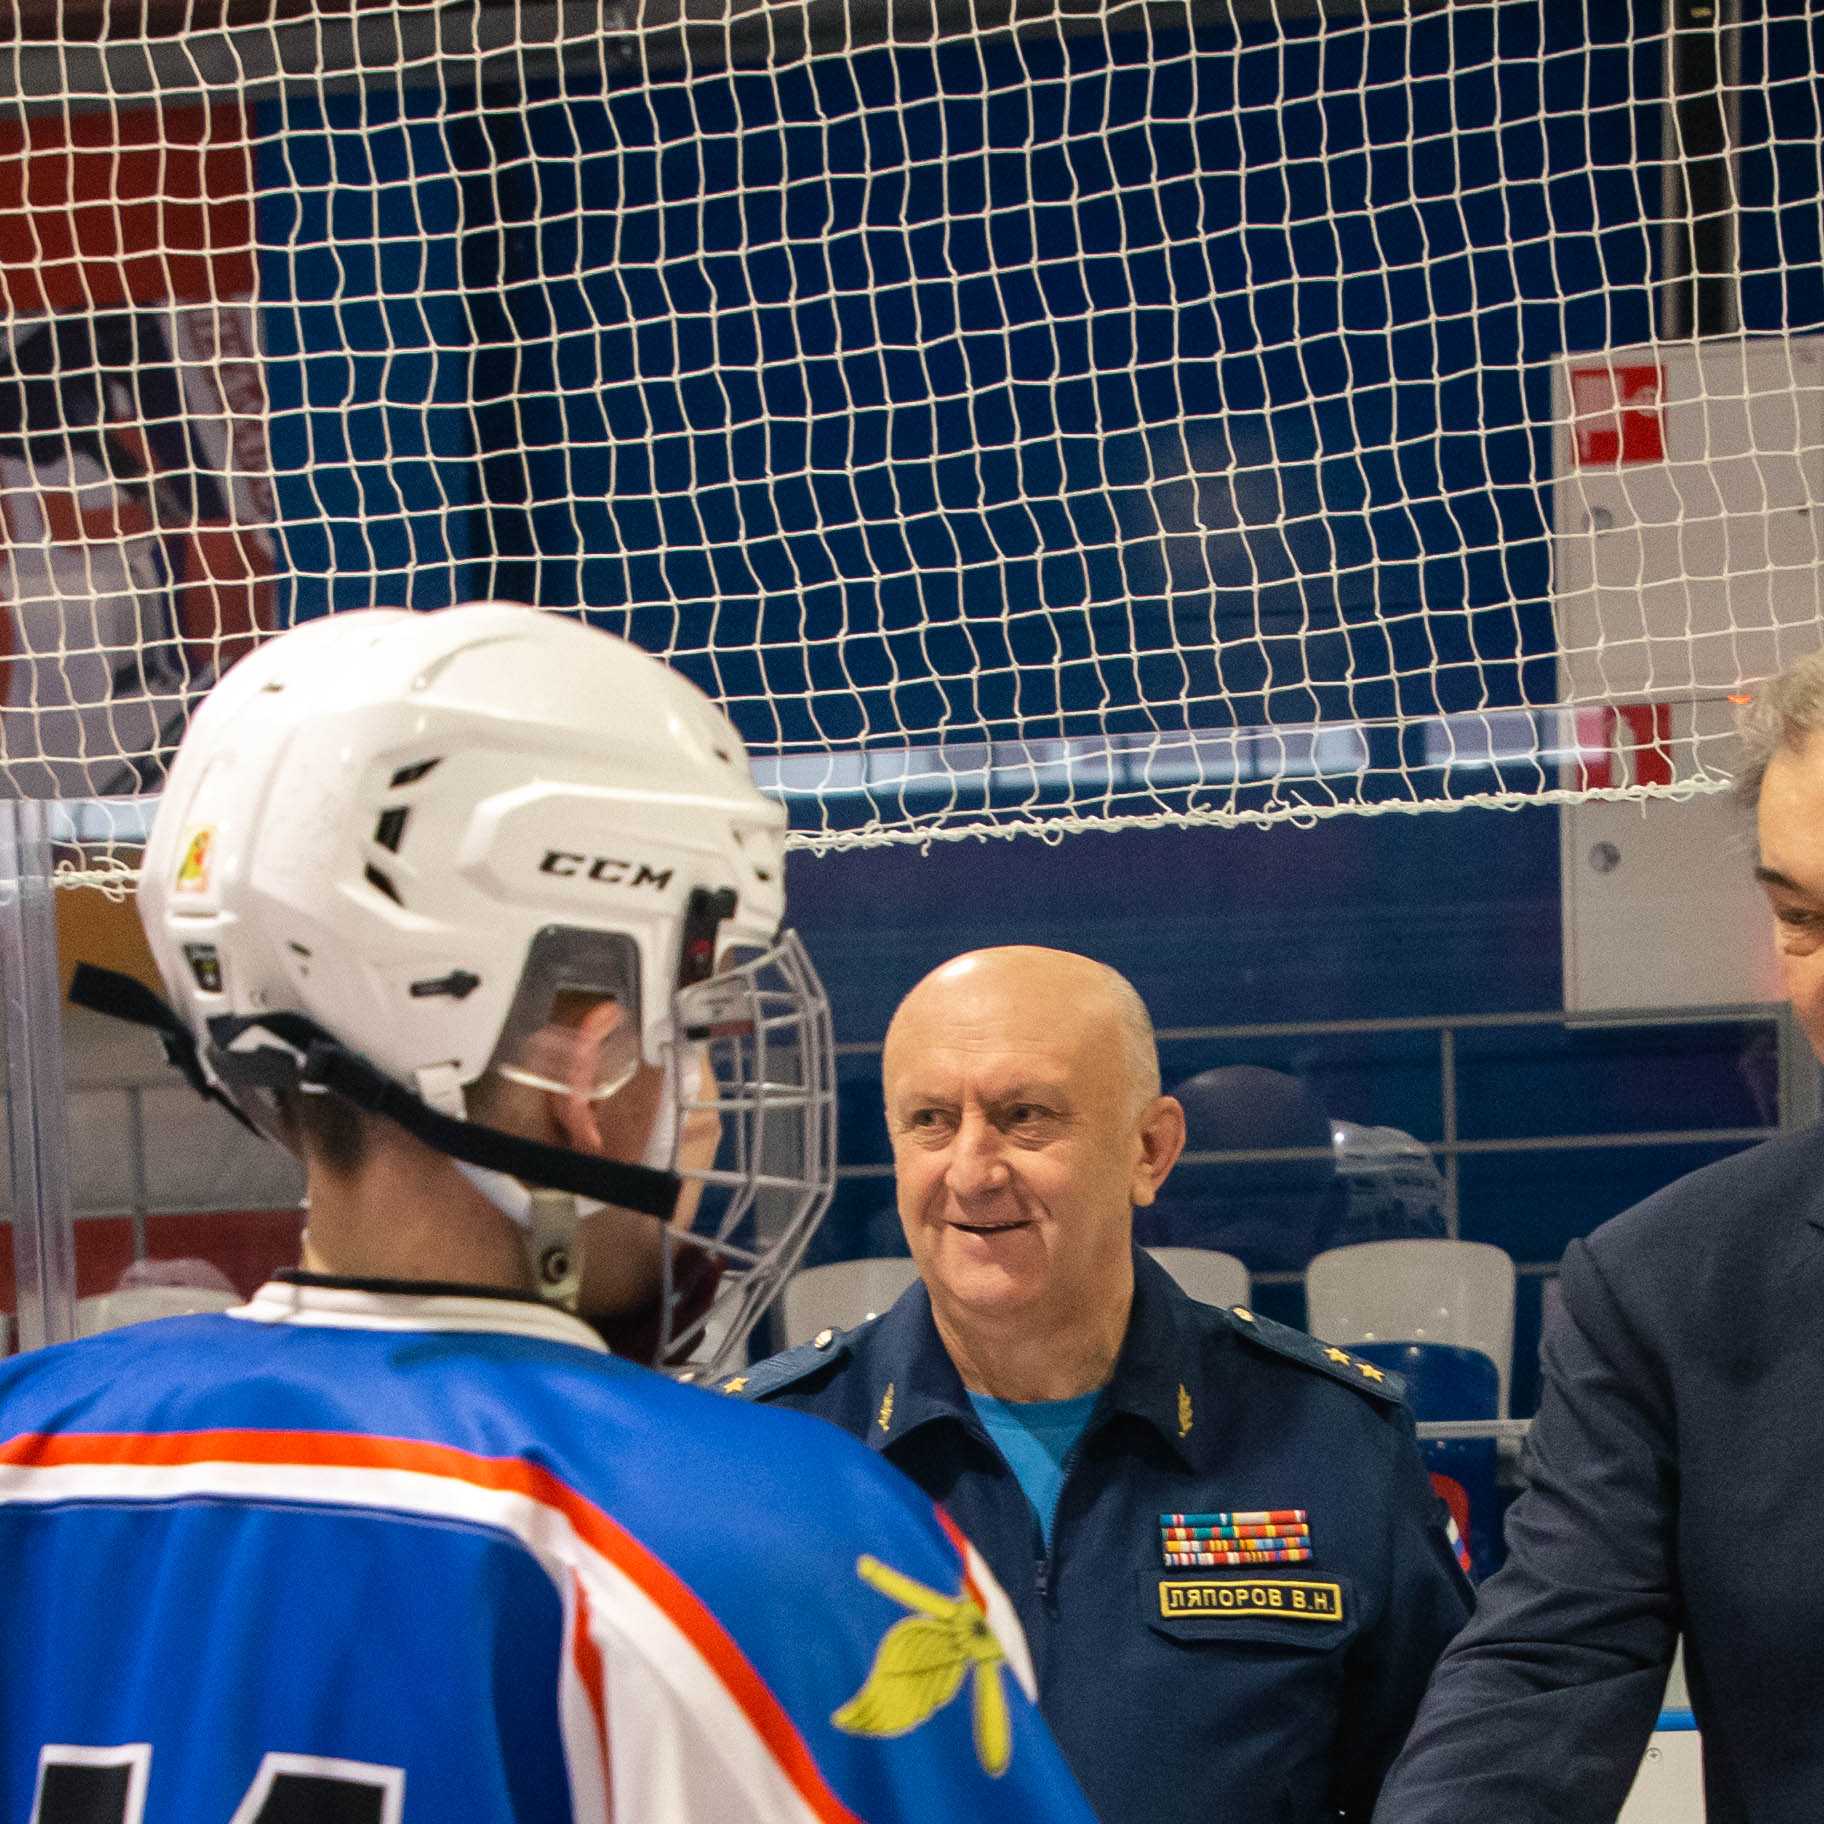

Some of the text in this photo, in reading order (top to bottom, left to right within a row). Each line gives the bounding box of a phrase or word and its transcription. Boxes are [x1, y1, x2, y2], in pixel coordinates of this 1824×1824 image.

[537, 849, 676, 893] CCM
[1168, 1588, 1335, 1611] ЛЯПОРОВ В.Н.
